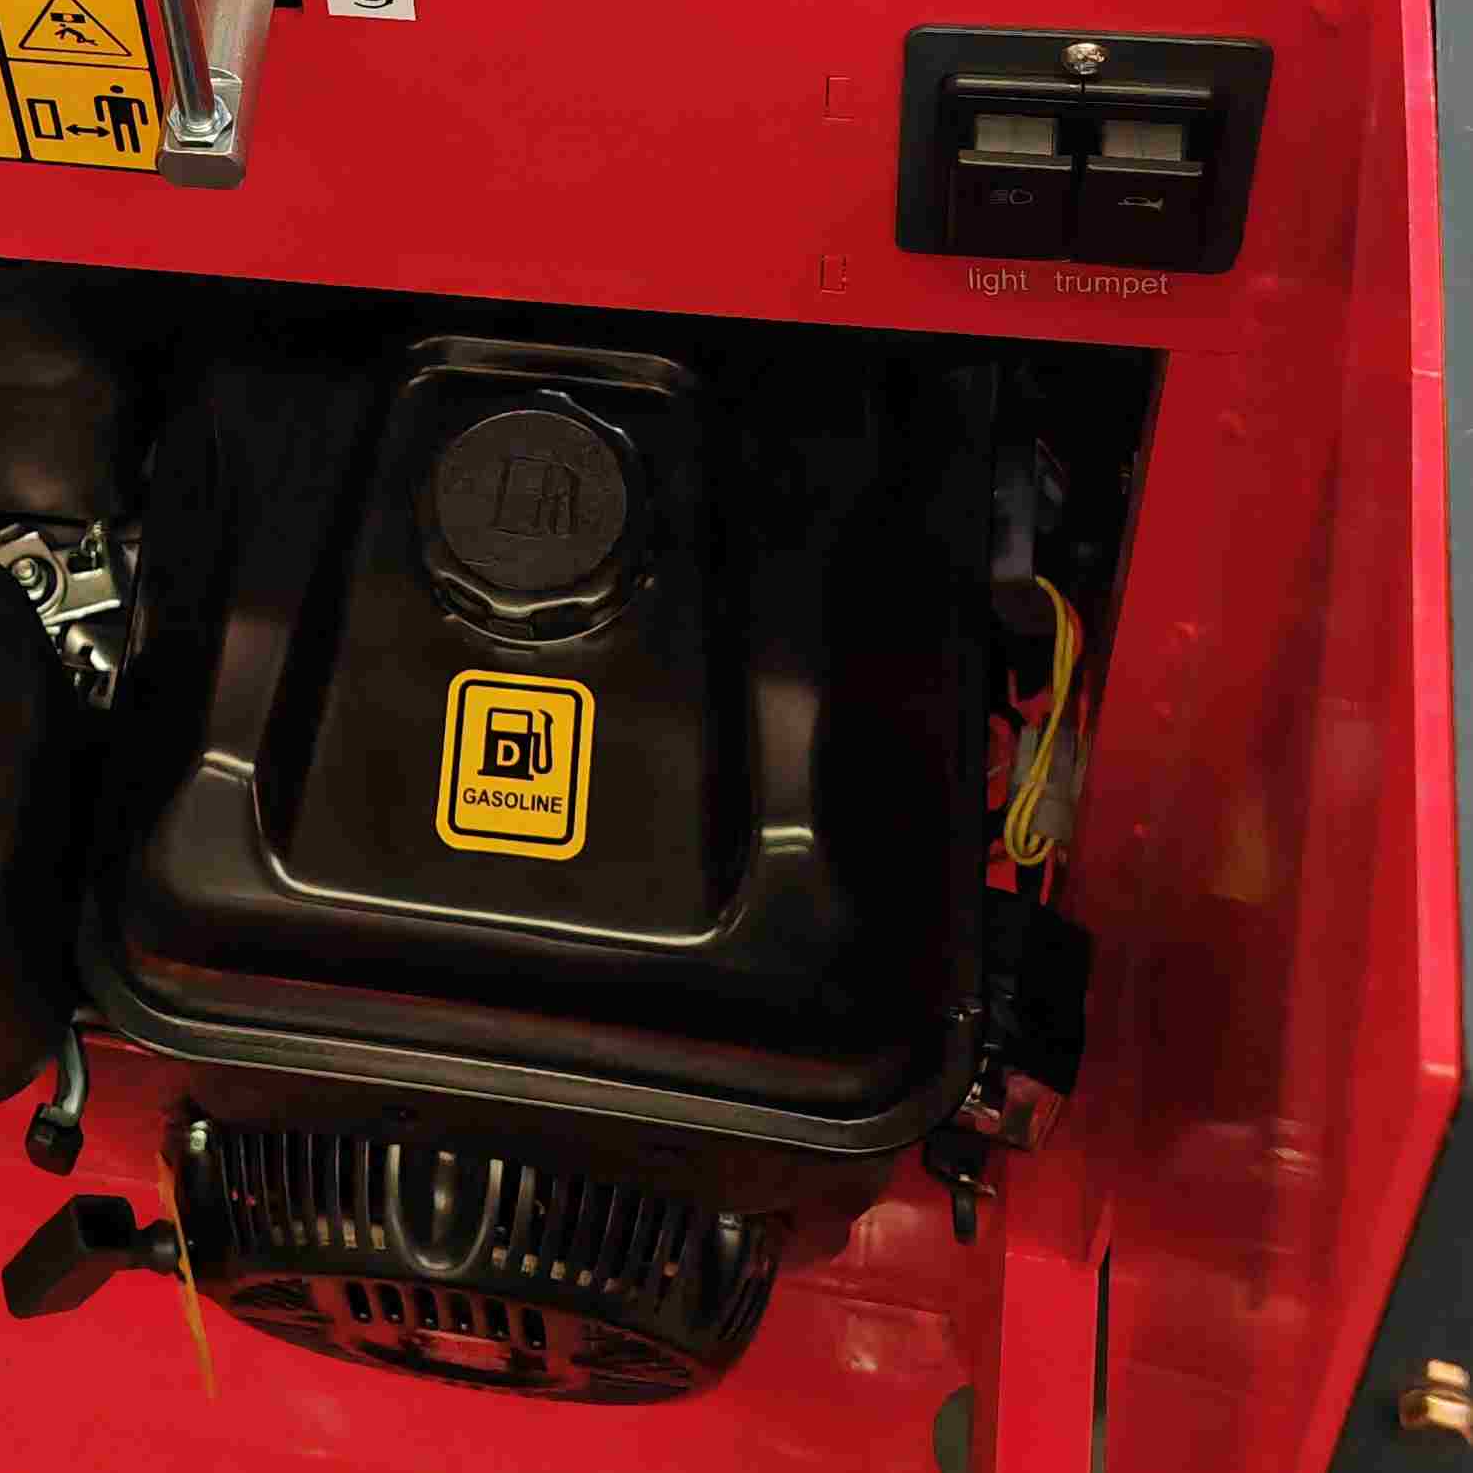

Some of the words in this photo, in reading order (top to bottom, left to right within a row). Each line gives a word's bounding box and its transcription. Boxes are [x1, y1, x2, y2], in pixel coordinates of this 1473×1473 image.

[967, 267, 1028, 296] light
[1053, 272, 1169, 298] trumpet
[496, 740, 521, 767] D
[462, 787, 563, 815] GASOLINE
